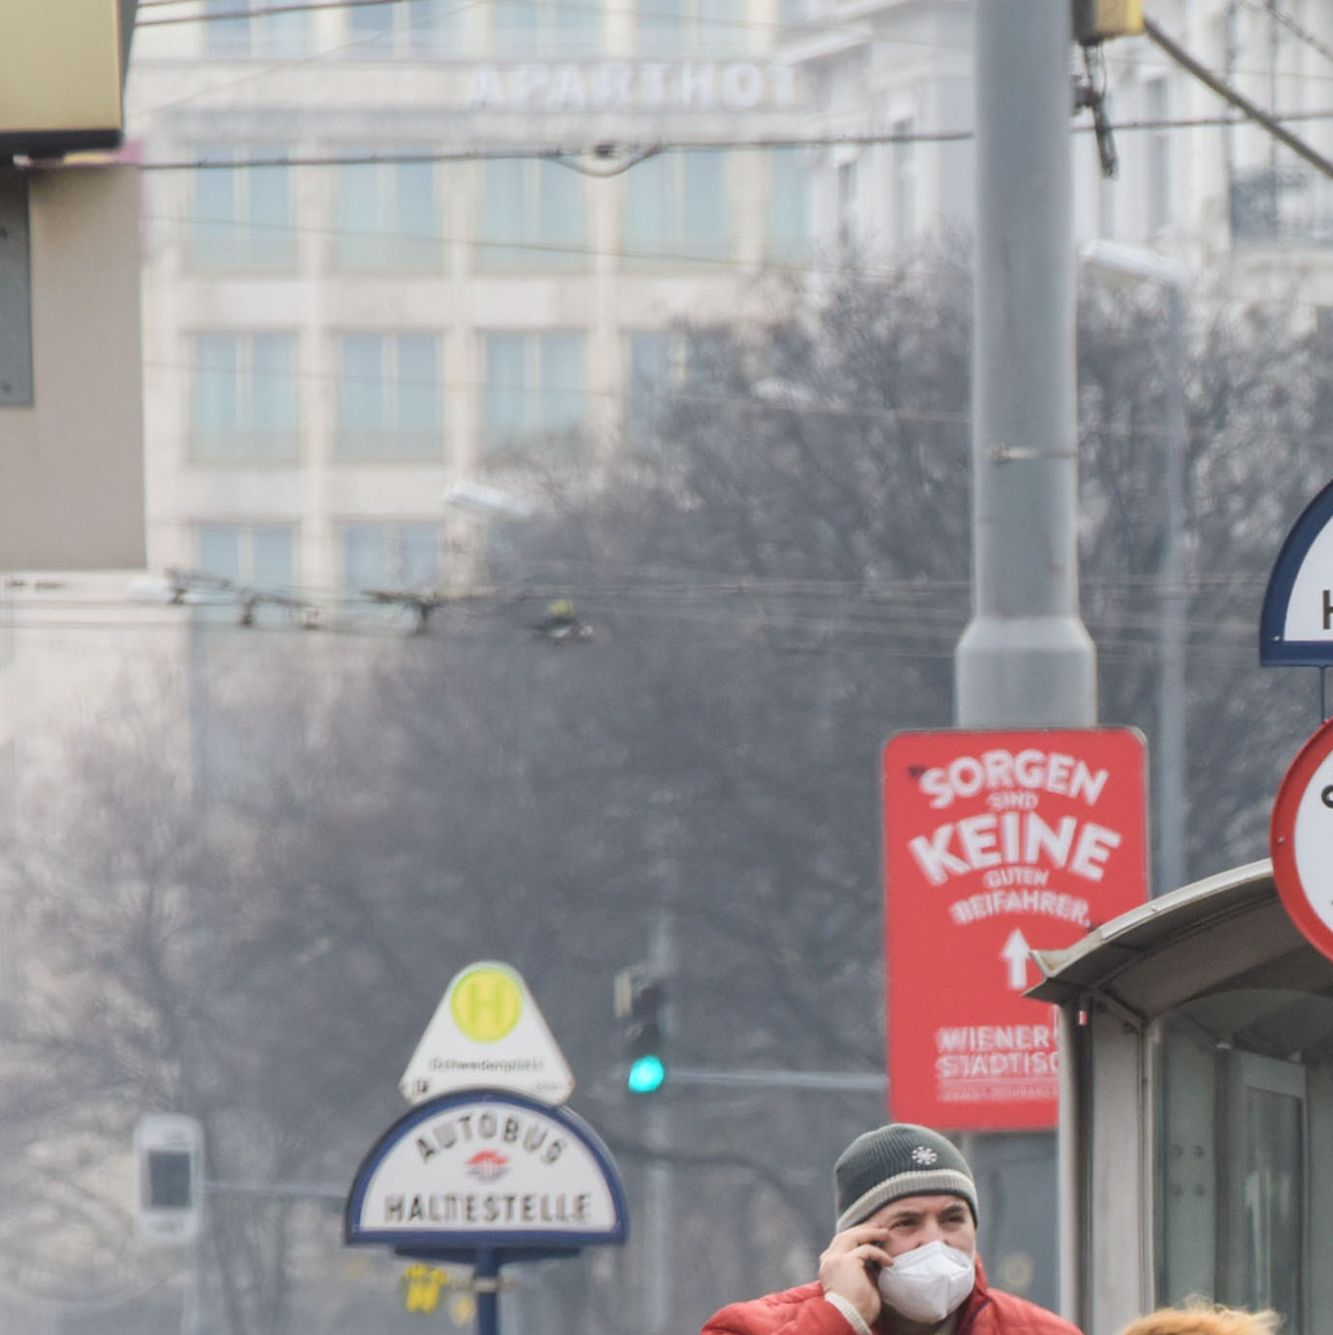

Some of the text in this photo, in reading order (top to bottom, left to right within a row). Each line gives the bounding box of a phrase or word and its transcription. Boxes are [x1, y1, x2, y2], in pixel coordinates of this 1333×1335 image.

[918, 748, 1110, 809] SORGEN
[986, 790, 1040, 811] SIND
[907, 810, 1123, 887] KEINE
[983, 865, 1050, 889] GUTEN
[937, 1025, 1050, 1052] WIENER
[415, 1111, 570, 1165] AUTOBUS
[383, 1192, 592, 1224] HALTESTELLE
